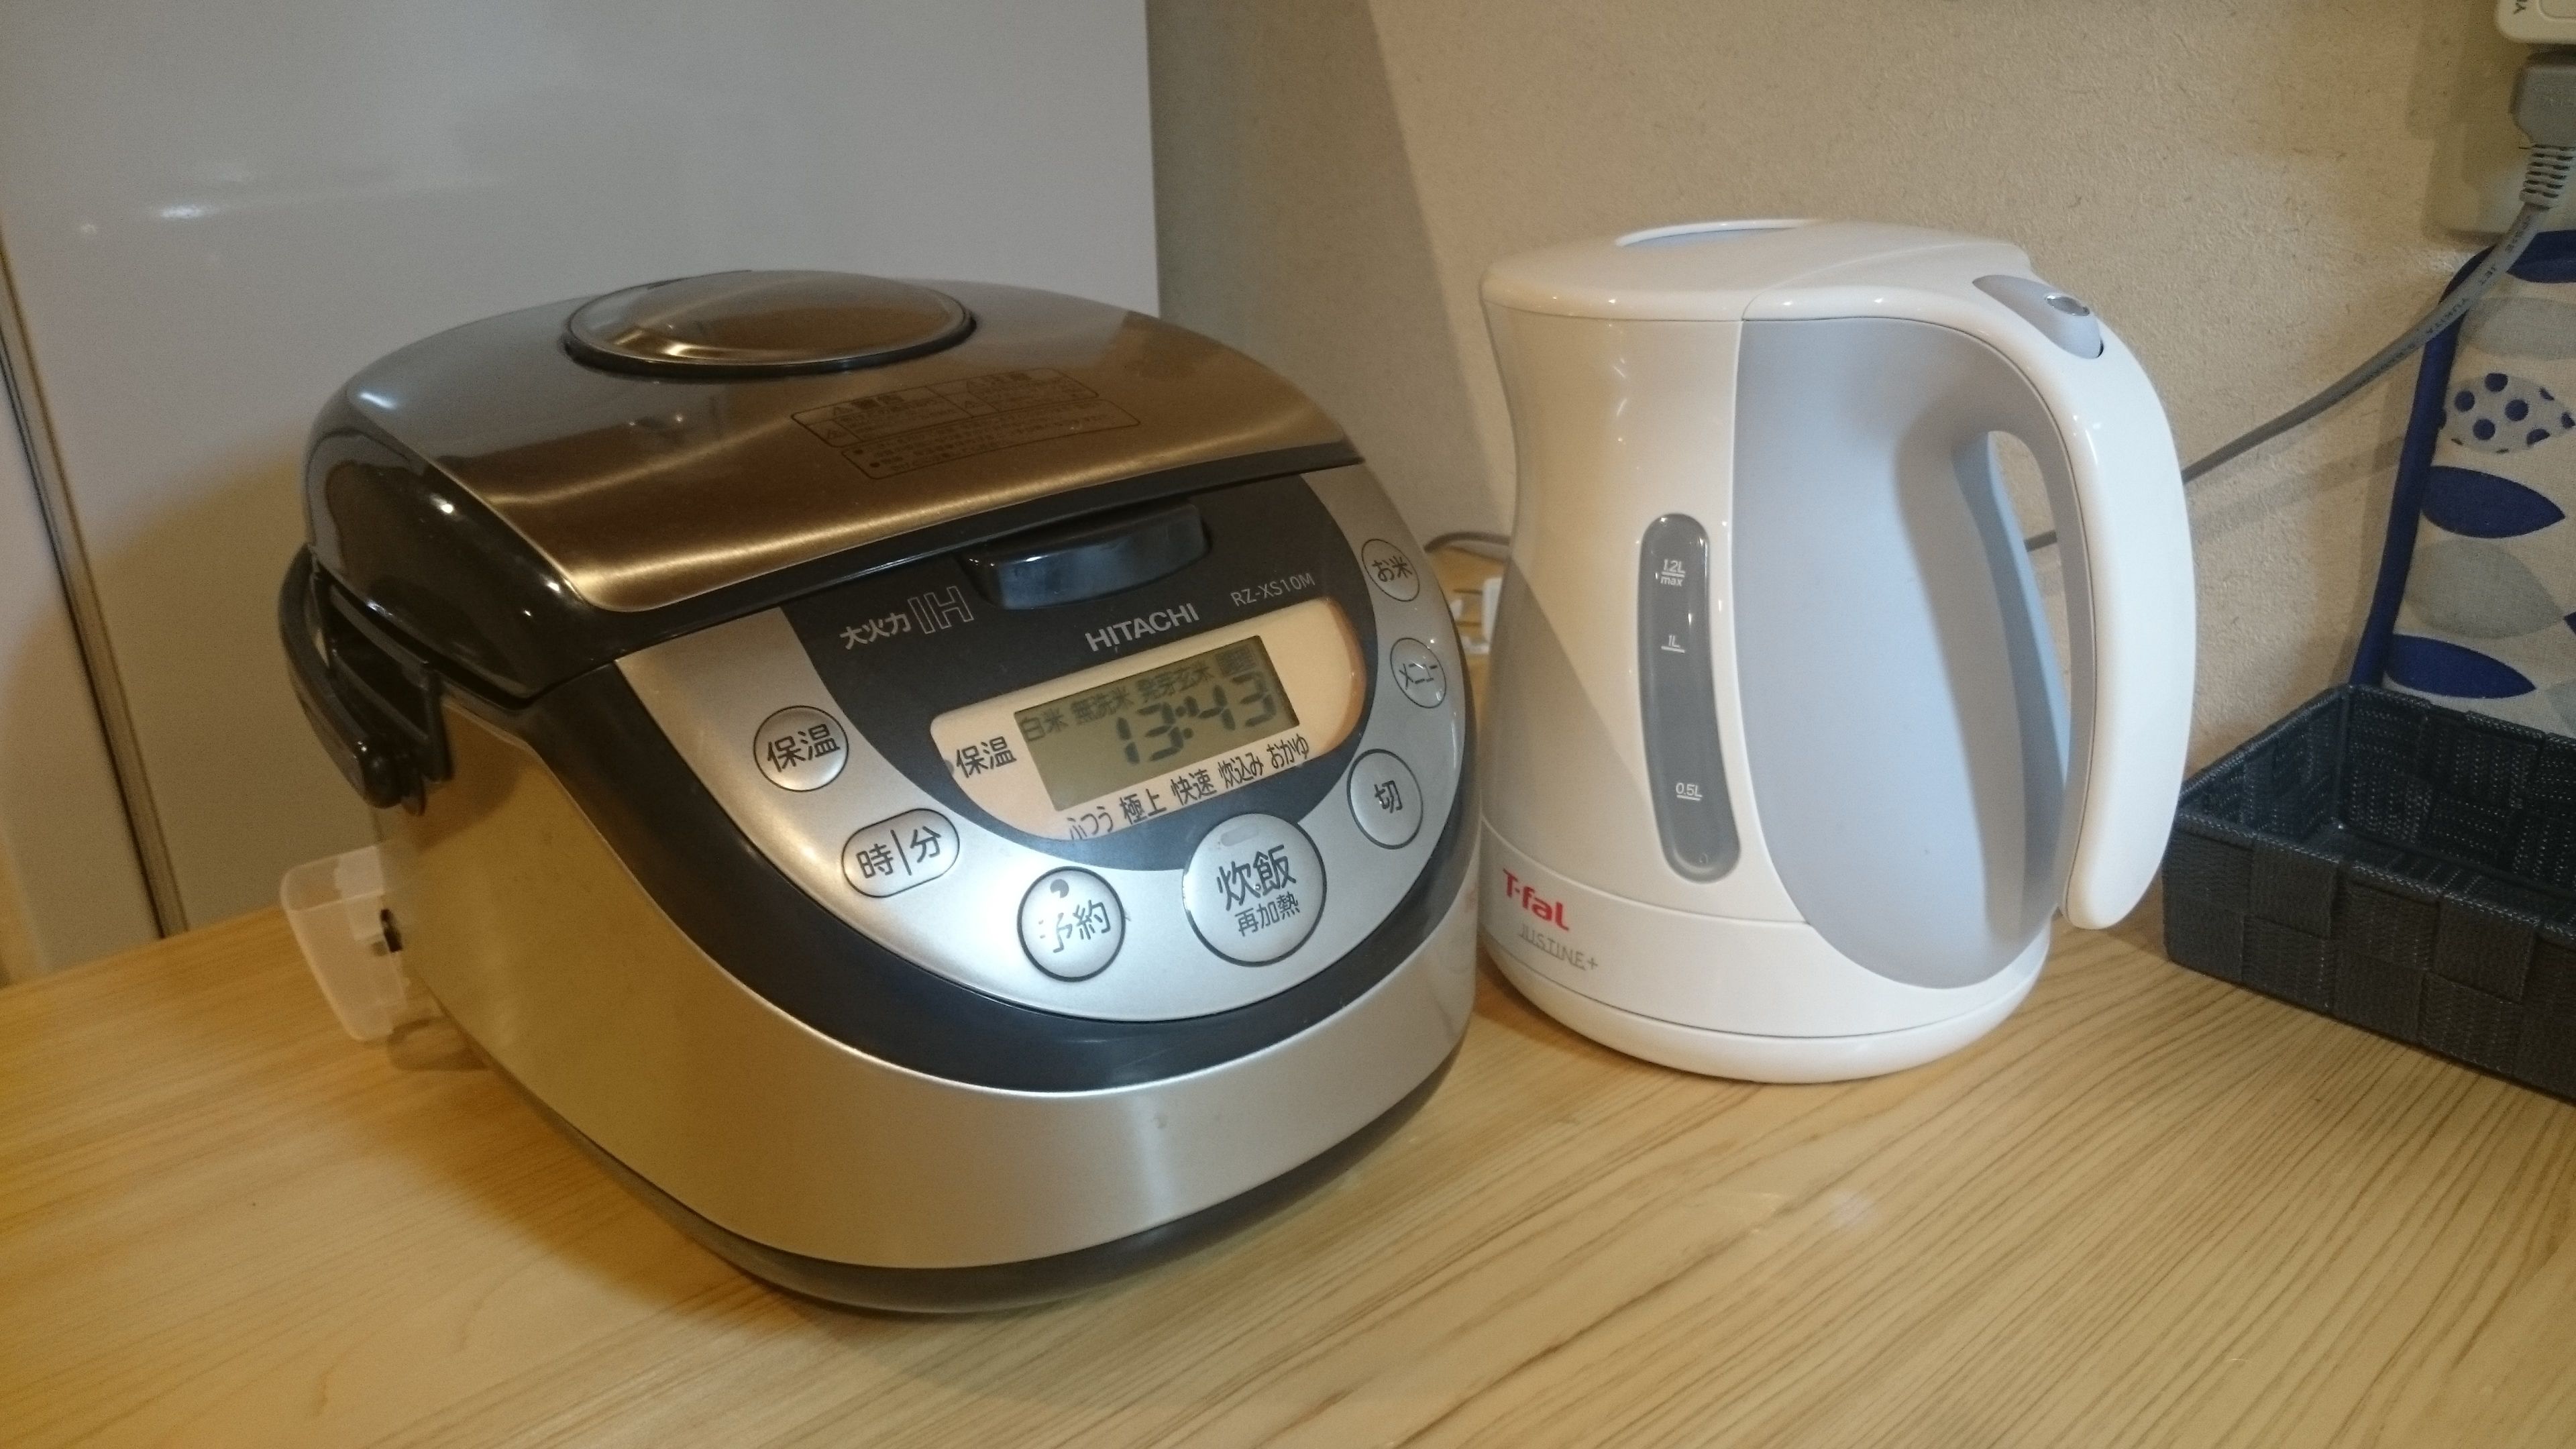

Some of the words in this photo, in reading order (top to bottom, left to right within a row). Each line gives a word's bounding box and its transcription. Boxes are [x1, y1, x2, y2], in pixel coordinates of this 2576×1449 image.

[1230, 573, 1316, 606] RZ-XS10M
[1373, 556, 1413, 582] お米
[1660, 576, 1683, 587] max
[840, 612, 911, 650] 大火力
[1085, 604, 1200, 651] HITACHI
[1668, 635, 1680, 649] 1L
[1020, 707, 1069, 742] 白米
[1070, 686, 1135, 726] 無洗米
[1115, 671, 1277, 765] 13:43
[766, 723, 841, 772] 保温
[955, 736, 1017, 778] 保温
[1068, 806, 1114, 840] ふつう
[1120, 788, 1167, 825] 極上
[1171, 769, 1218, 806] 快速
[1218, 752, 1264, 789] 炊込み
[1267, 733, 1309, 769] おかゆ
[1374, 780, 1403, 813] 切
[1676, 783, 1703, 798] 0.5L
[1216, 844, 1297, 911] 炊飯
[1235, 890, 1300, 936] 再加熱
